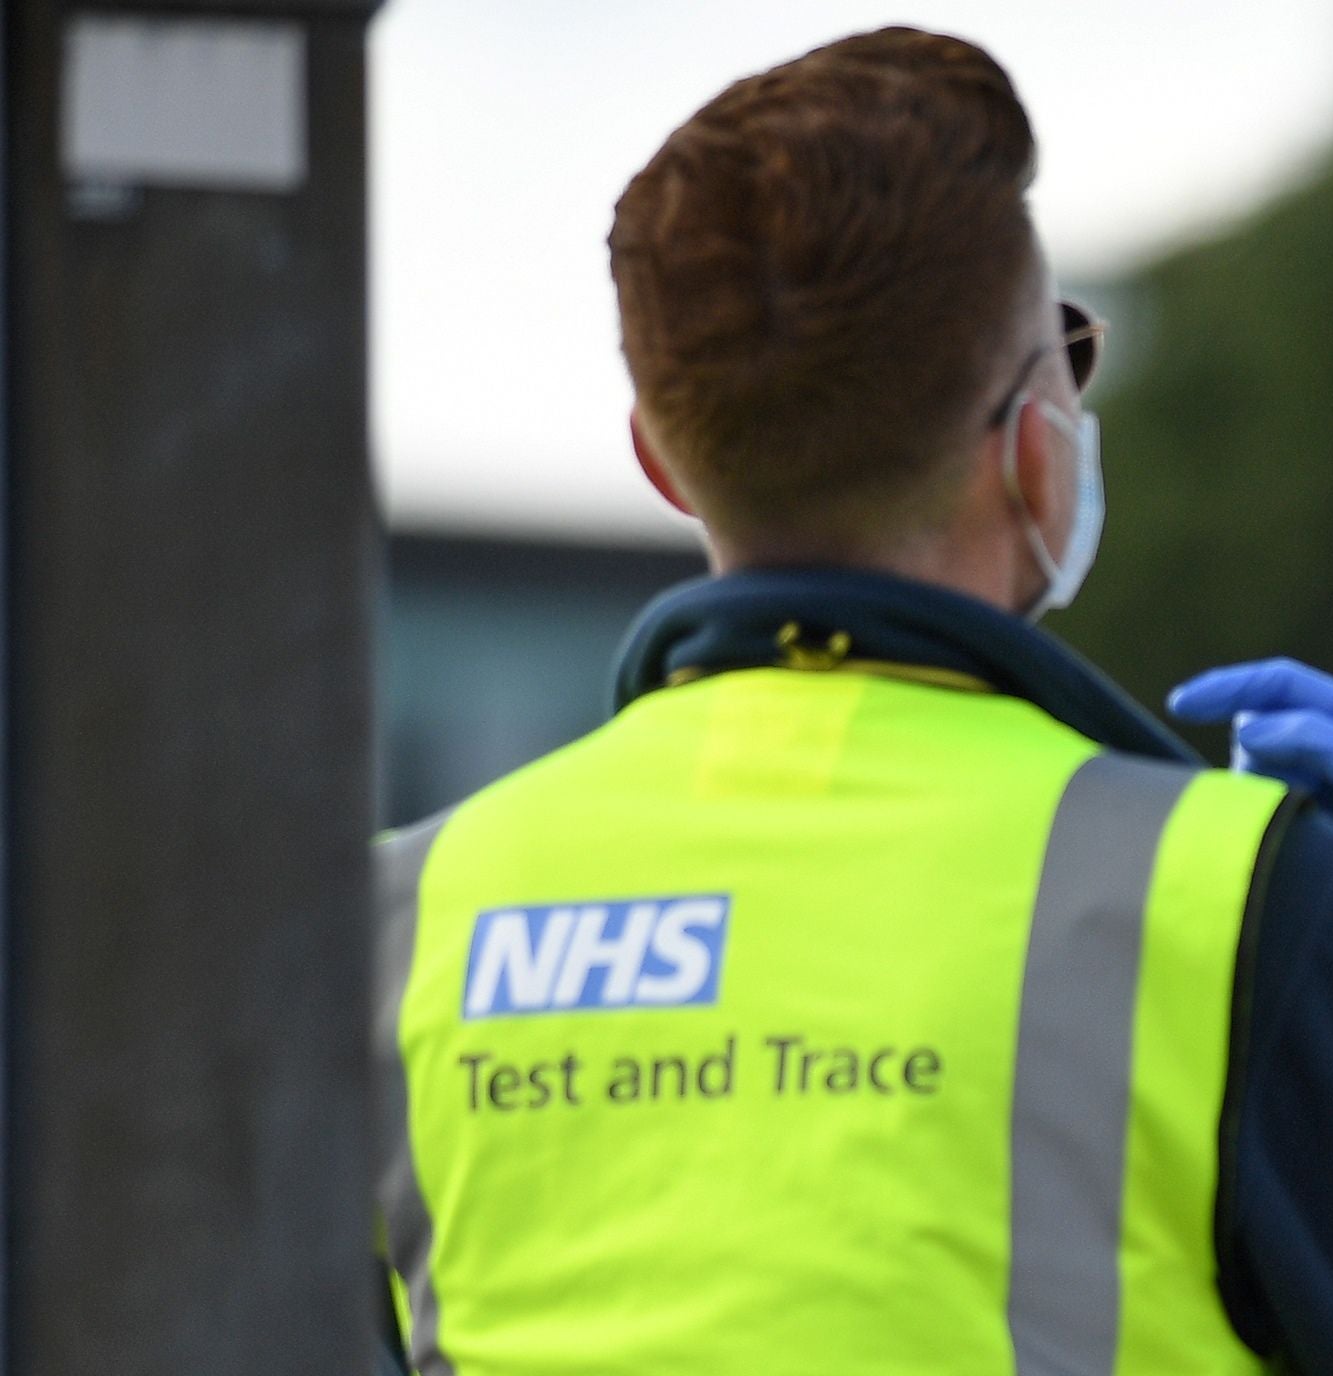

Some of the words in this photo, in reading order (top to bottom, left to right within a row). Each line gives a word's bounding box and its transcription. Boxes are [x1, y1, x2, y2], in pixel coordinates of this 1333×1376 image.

[465, 897, 727, 1014] NHS
[458, 1053, 582, 1114] Test
[607, 1032, 738, 1102] and
[765, 1035, 944, 1097] Trace
